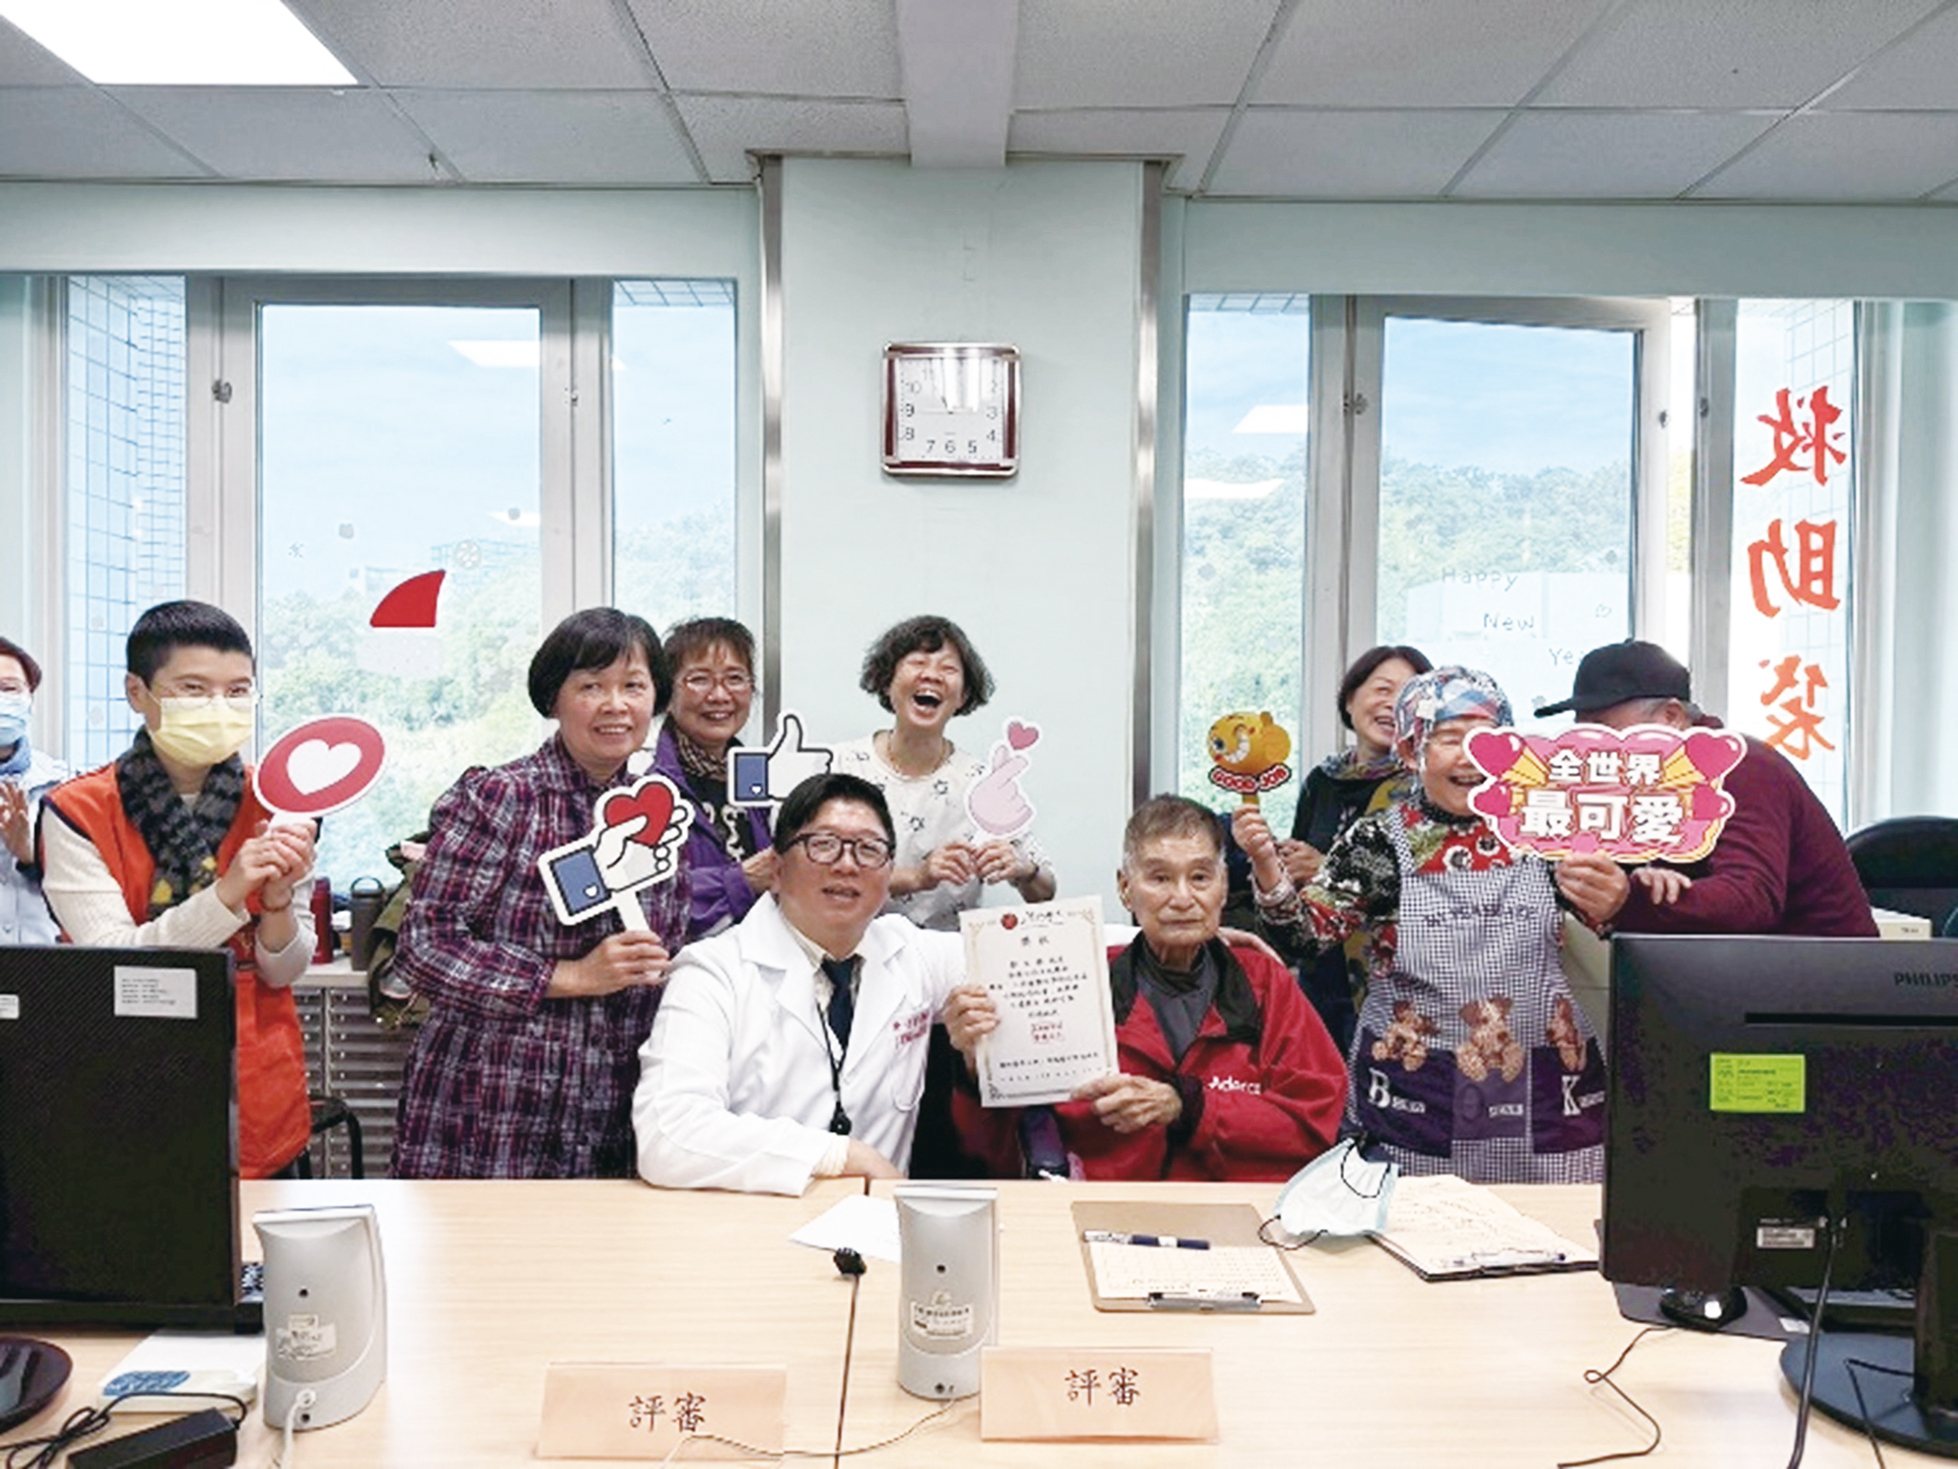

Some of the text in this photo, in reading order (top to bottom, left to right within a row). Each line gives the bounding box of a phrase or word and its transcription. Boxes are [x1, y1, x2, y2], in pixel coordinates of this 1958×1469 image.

[986, 406, 998, 420] 3
[986, 429, 996, 442] 4
[926, 440, 936, 453] 7
[944, 440, 956, 454] 6
[967, 440, 977, 454] 5
[1441, 567, 1519, 592] Happy
[1484, 612, 1535, 631] New
[1548, 648, 1584, 666] Ye
[1549, 749, 1663, 786] 全世界
[1521, 790, 1684, 846] 最可愛
[1064, 1366, 1141, 1407] 評審
[628, 1391, 706, 1433] 評審
